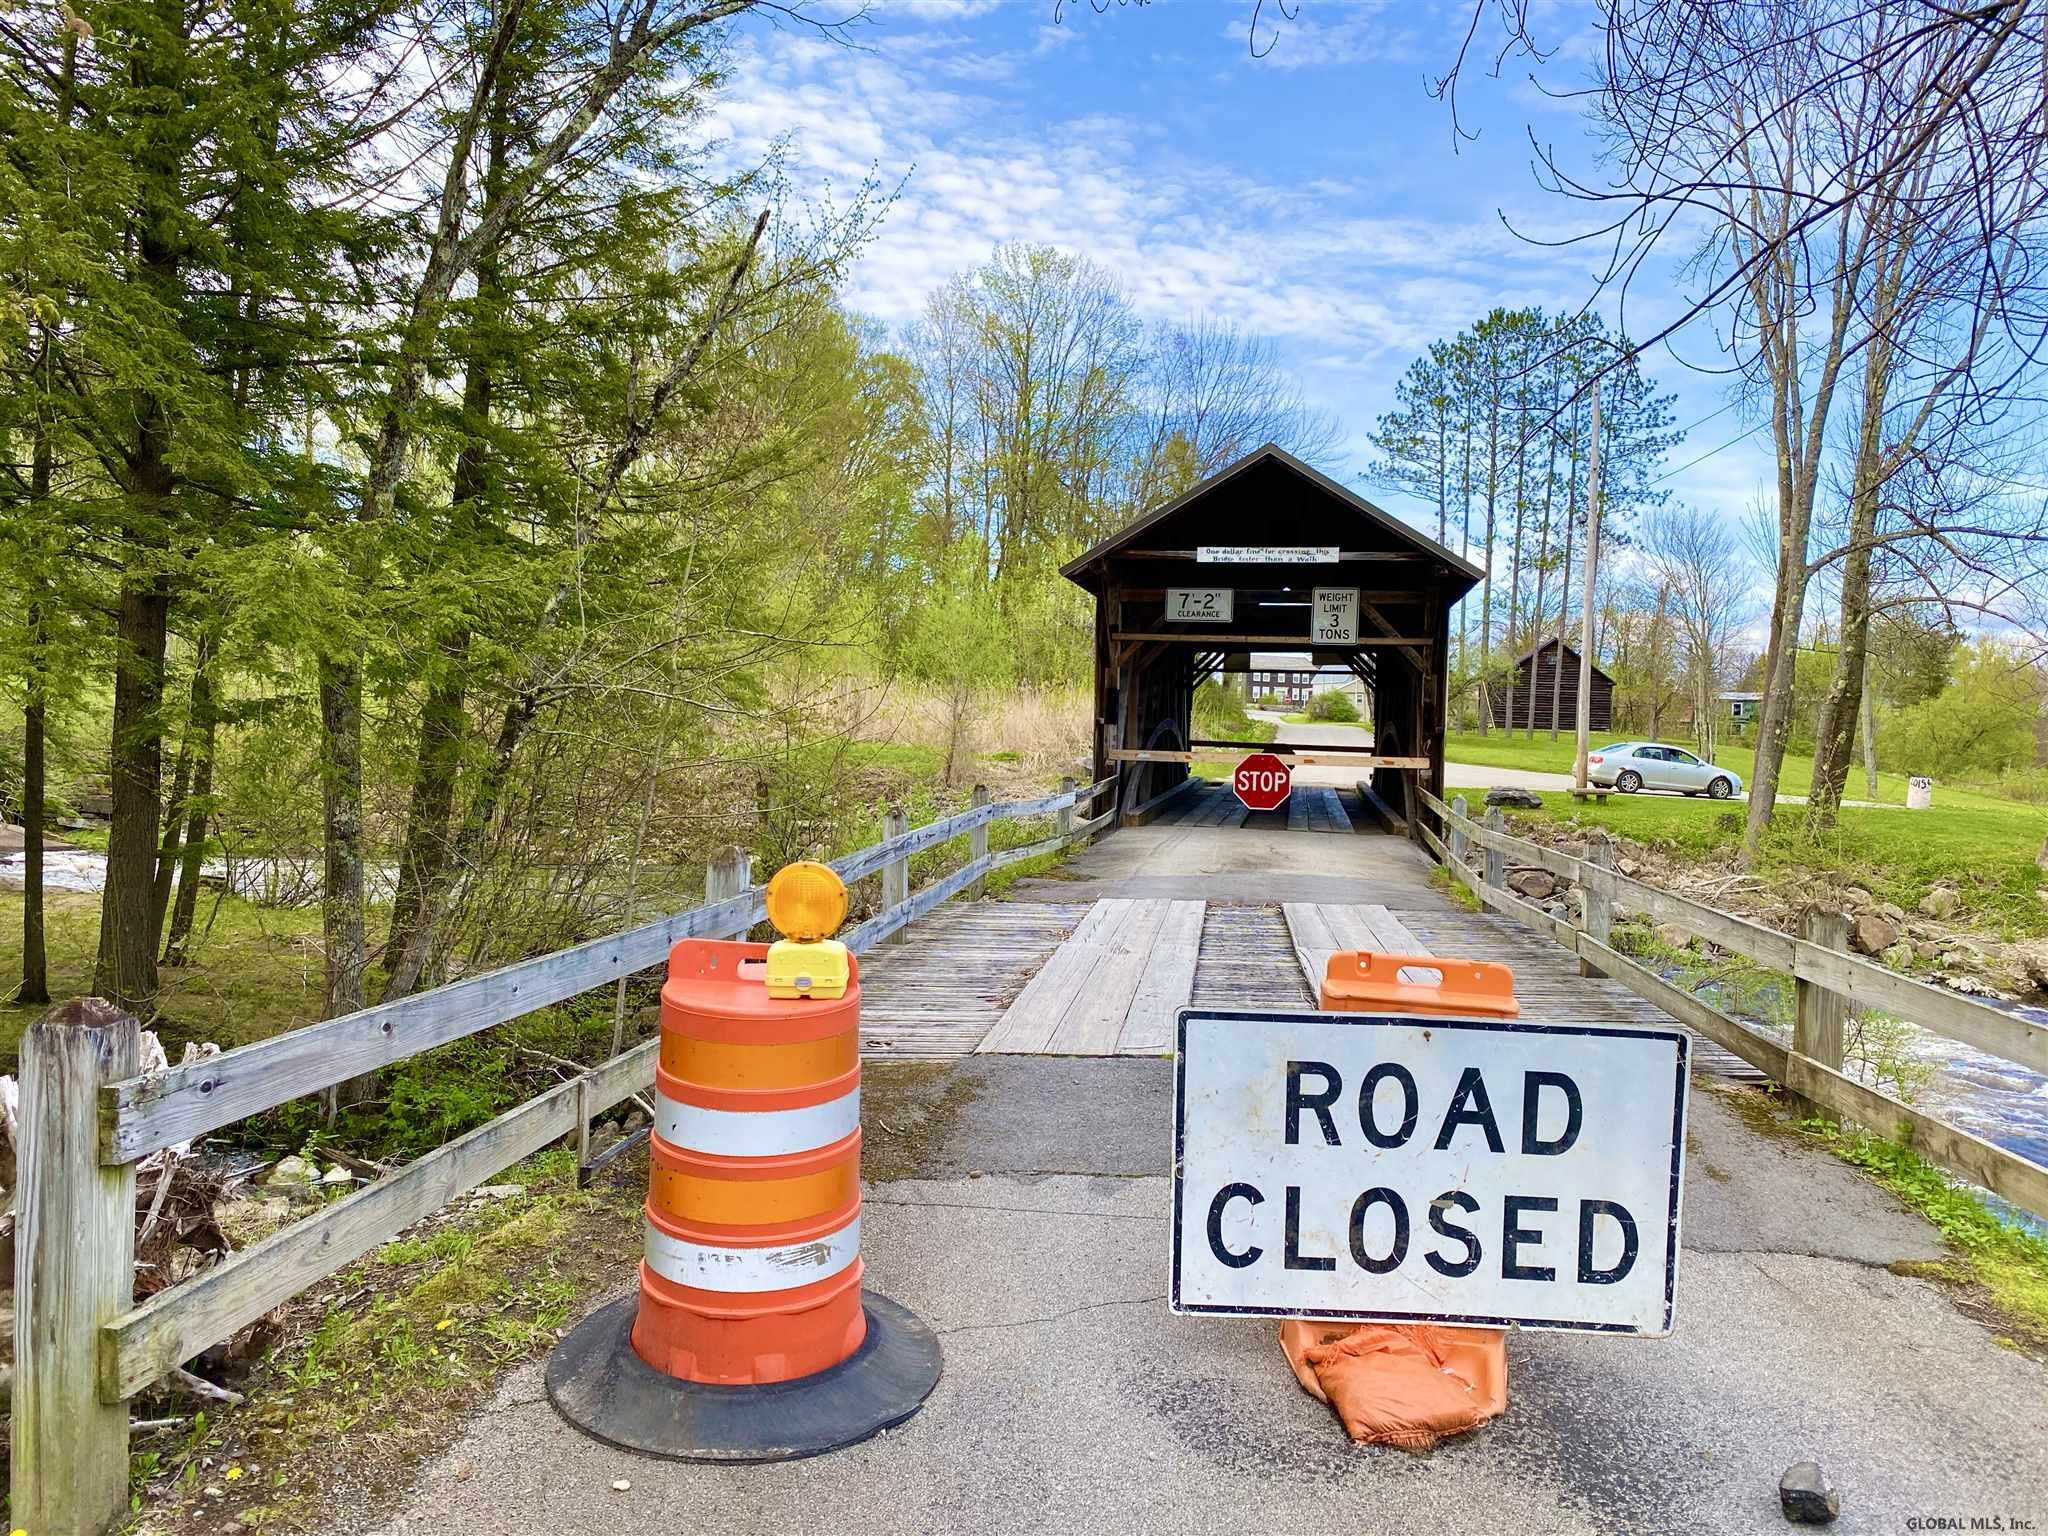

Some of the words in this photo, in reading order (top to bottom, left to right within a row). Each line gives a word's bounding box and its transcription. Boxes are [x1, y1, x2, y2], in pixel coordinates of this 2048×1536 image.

[1222, 547, 1243, 555] dollar
[1178, 593, 1221, 609] 7'-2"
[1319, 592, 1354, 602] WEIGHT
[1177, 610, 1221, 618] CLEARANCE
[1323, 604, 1347, 613] LIMIT
[1330, 613, 1340, 628] 3
[1319, 629, 1350, 640] TONS
[1237, 770, 1287, 792] STOP
[1284, 1060, 1583, 1156] ROAD
[1206, 1182, 1640, 1285] CLOSED
